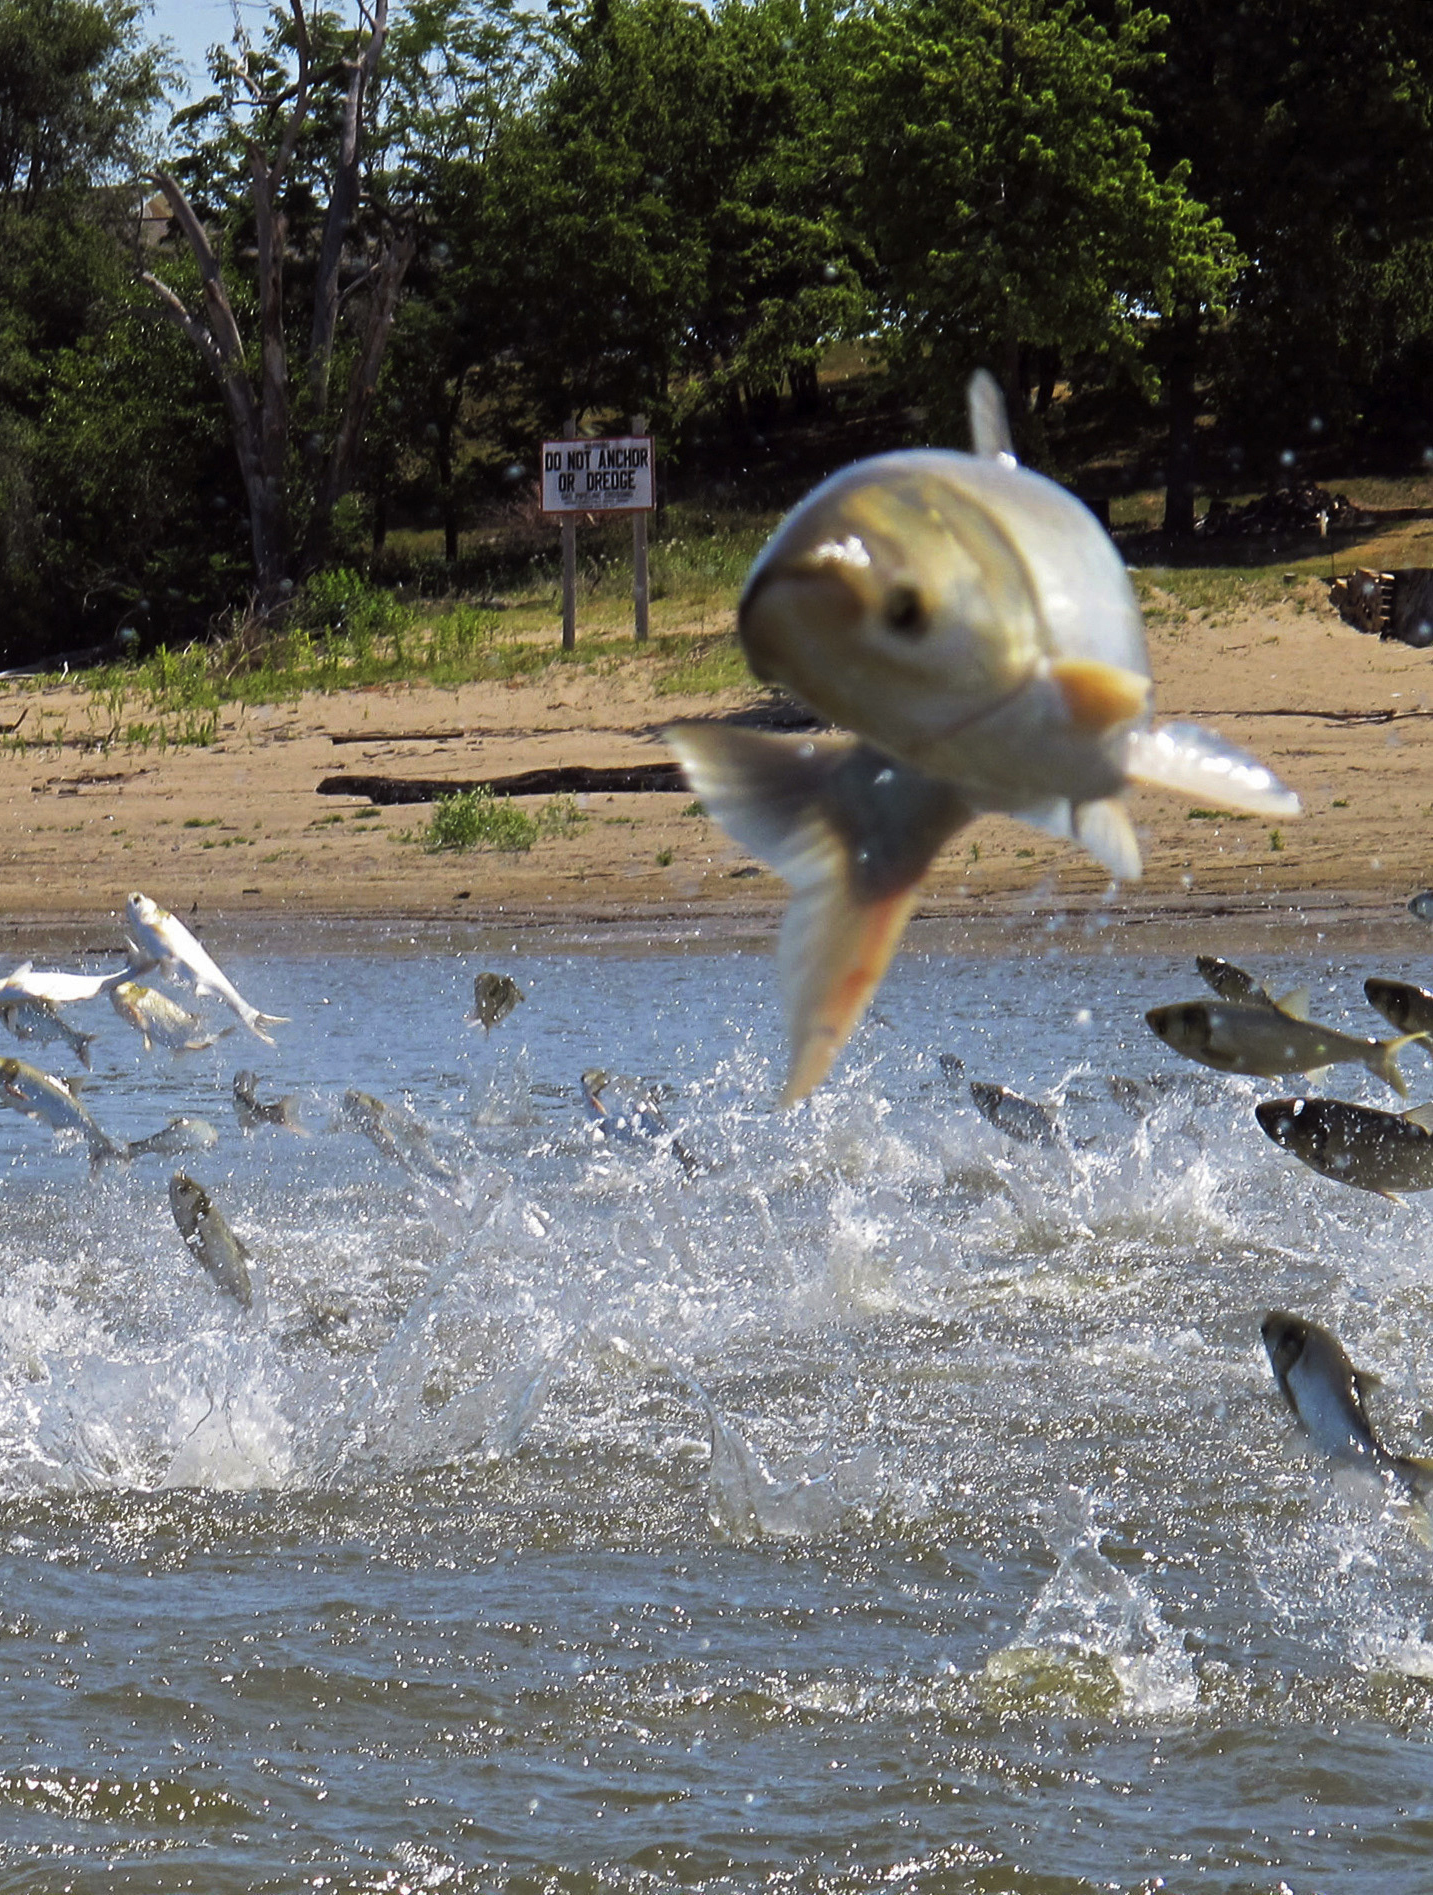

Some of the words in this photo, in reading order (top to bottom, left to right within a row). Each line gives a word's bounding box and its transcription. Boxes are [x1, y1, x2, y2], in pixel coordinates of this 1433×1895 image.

[545, 452, 562, 472] DO
[567, 450, 591, 471] NOT
[598, 448, 649, 469] ANCHOR
[558, 473, 575, 492] OR
[586, 470, 636, 491] DREDGE
